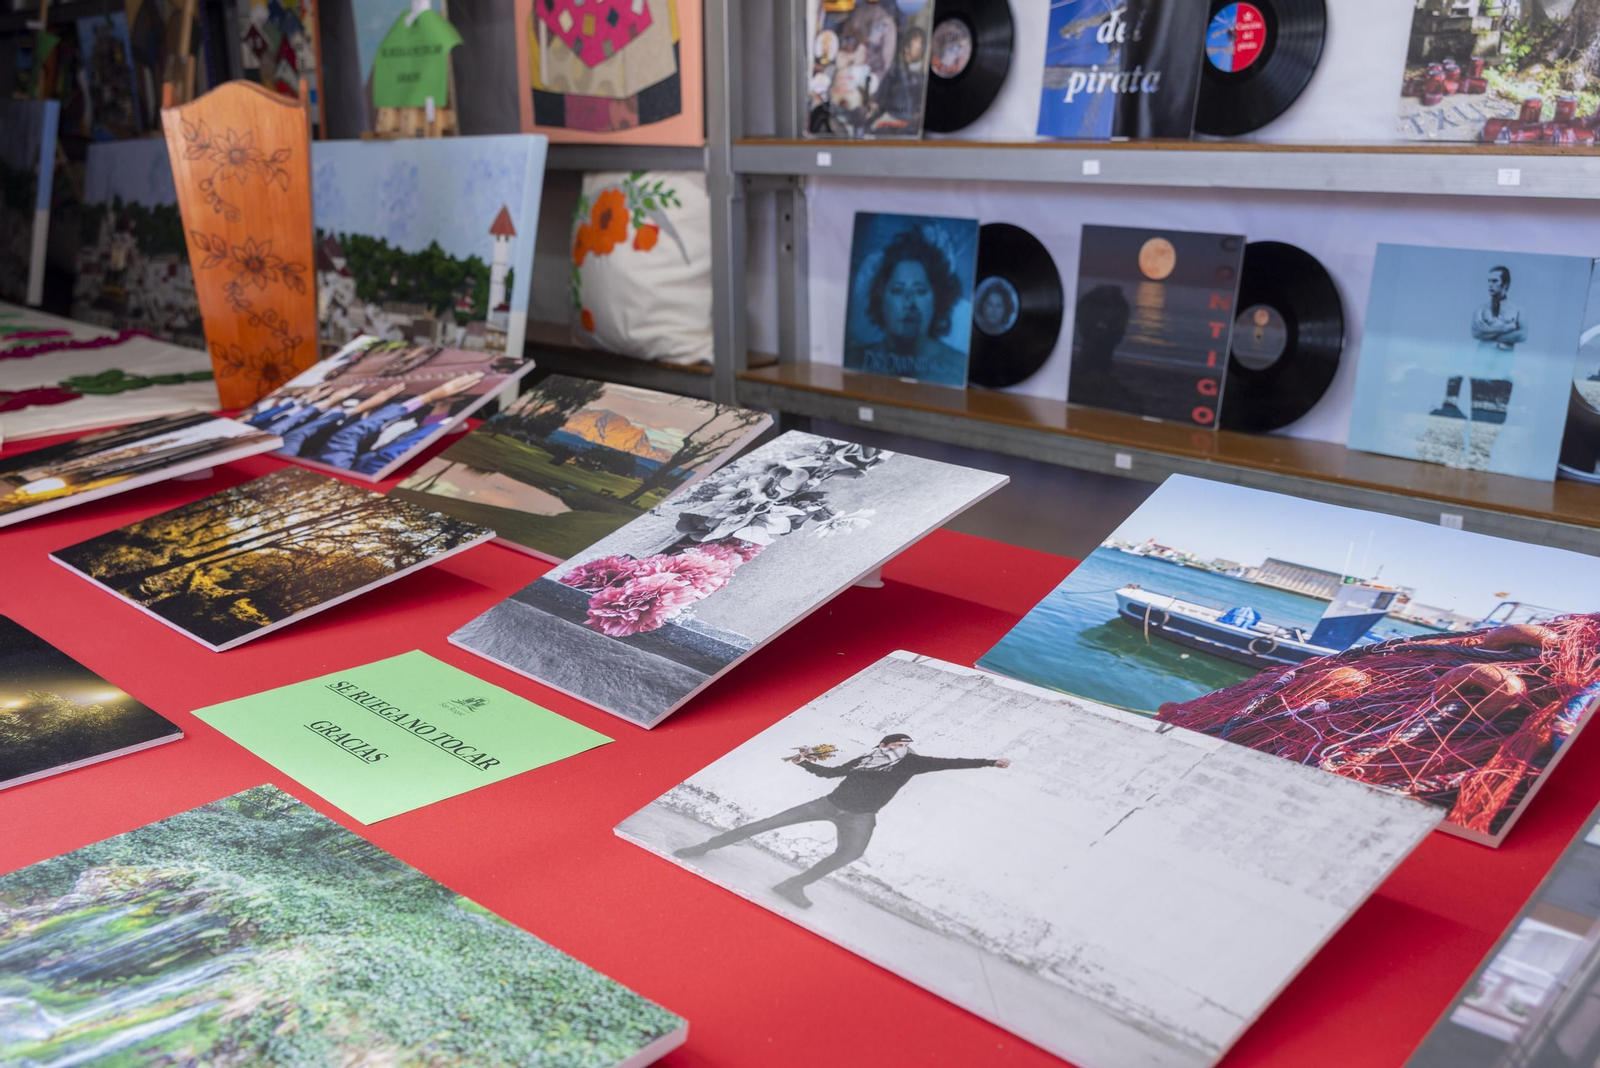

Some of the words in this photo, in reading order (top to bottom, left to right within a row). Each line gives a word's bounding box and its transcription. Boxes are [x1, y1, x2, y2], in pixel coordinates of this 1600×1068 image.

[1063, 64, 1161, 103] pirata
[1191, 236, 1239, 425] CONTIGO
[307, 719, 389, 764] GRACIAS
[327, 680, 358, 695] SE
[352, 689, 410, 725] RUEGA
[402, 718, 437, 736] NO
[427, 731, 501, 772] TOCAR
